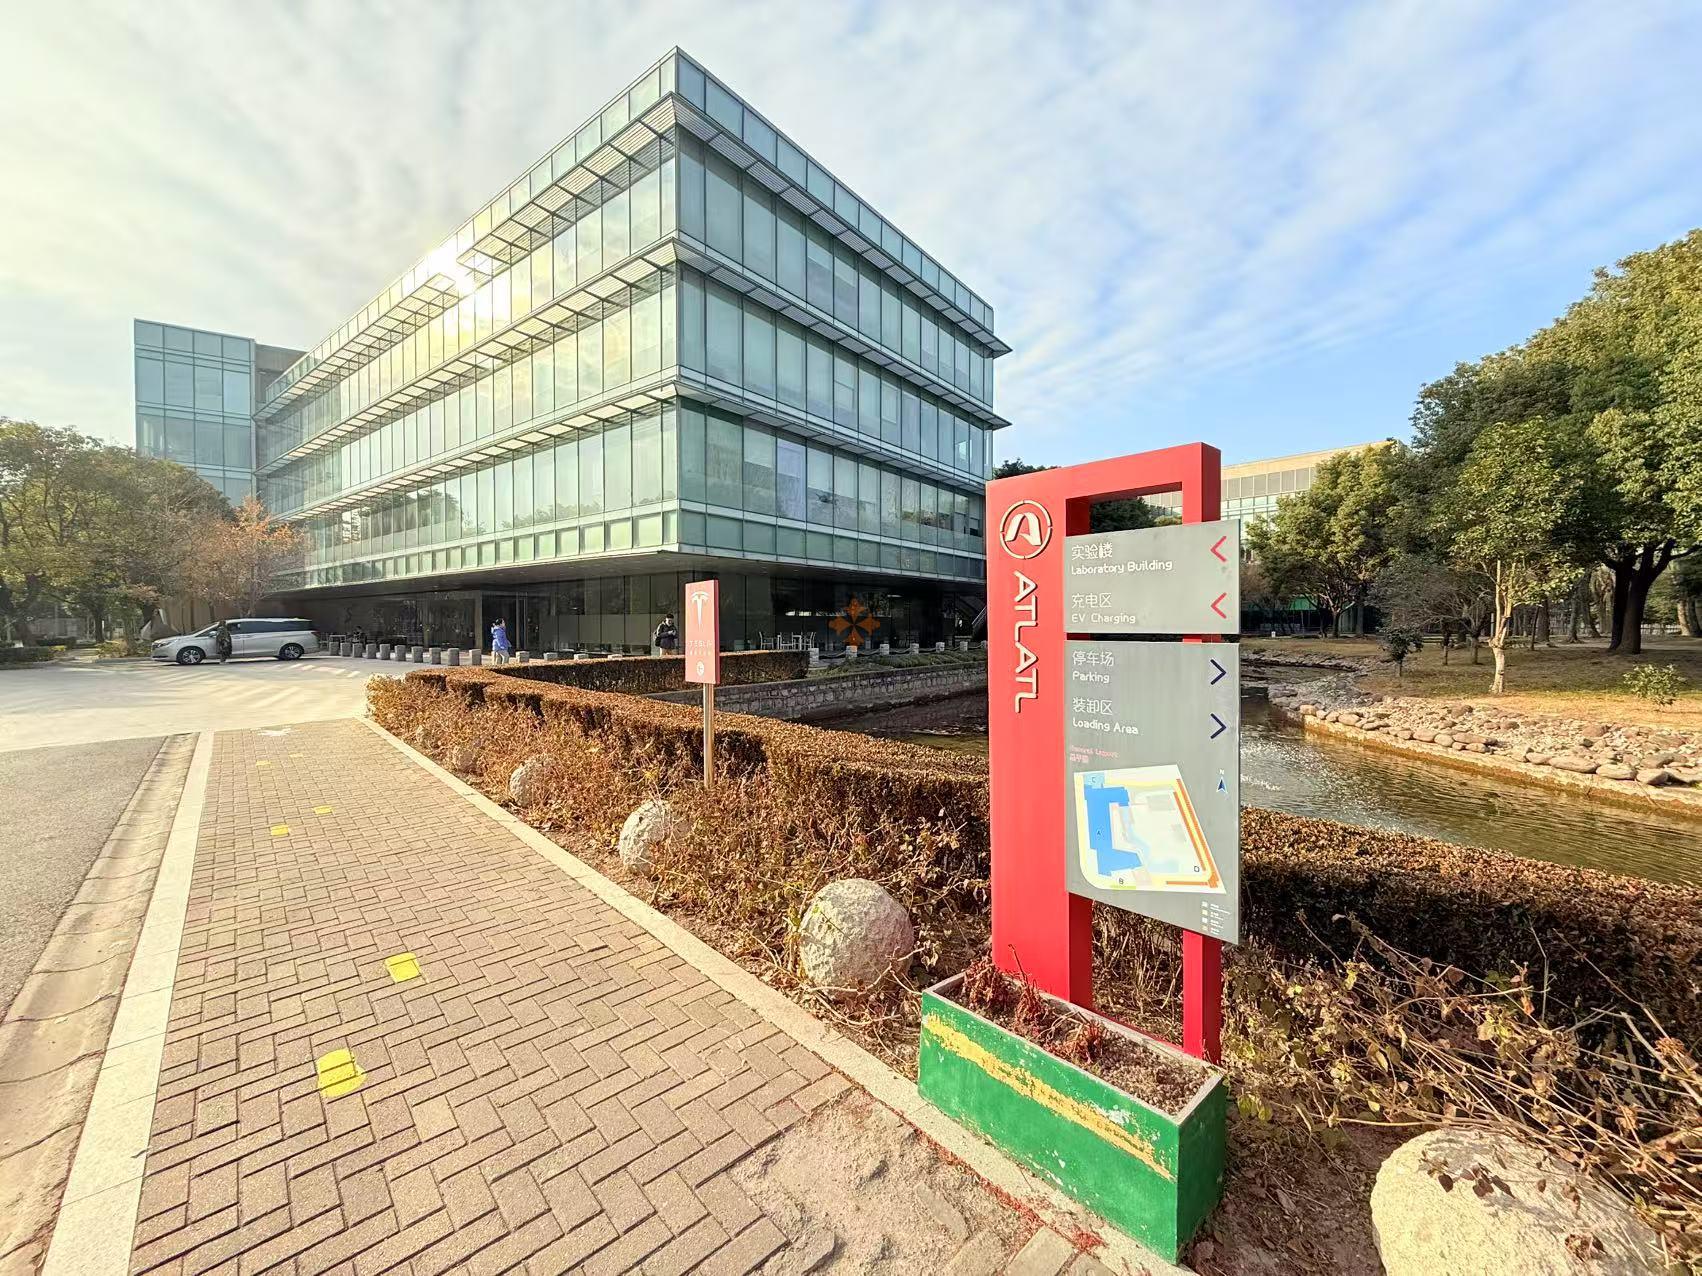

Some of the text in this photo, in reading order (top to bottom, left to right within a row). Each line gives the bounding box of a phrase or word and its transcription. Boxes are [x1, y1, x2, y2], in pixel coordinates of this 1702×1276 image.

[1071, 542, 1113, 561] 实验楼
[1071, 559, 1173, 575] Laboratory Building
[1071, 592, 1112, 609] 充电区
[1071, 612, 1136, 624] EV Charging
[1014, 570, 1038, 714] ATLATL
[1072, 650, 1115, 667] 停车场
[1072, 670, 1110, 684] Parking
[1072, 697, 1113, 715] 装卸区
[1072, 717, 1139, 734] Loading Area
